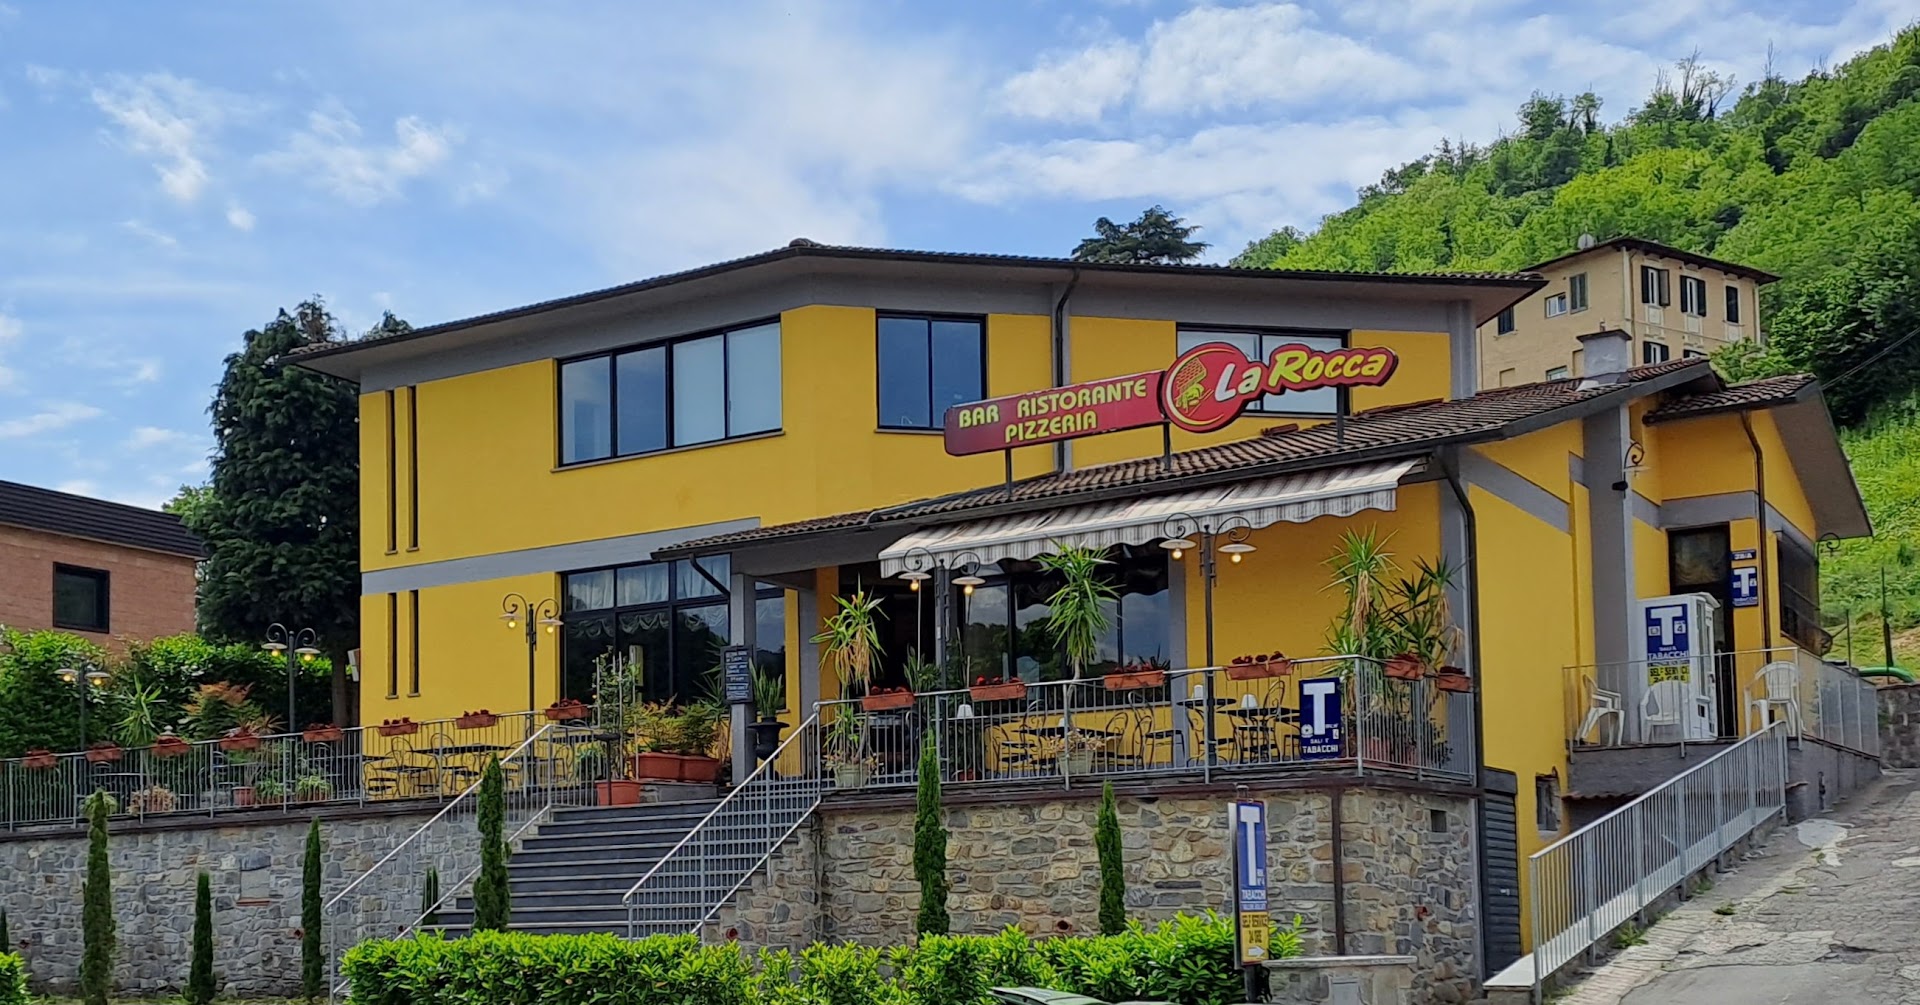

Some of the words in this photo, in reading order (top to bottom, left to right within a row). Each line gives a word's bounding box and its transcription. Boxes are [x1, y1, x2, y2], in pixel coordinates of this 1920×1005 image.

[1214, 363, 1262, 402] La
[1267, 350, 1387, 387] Rocca
[958, 404, 999, 428] BAR
[1017, 378, 1147, 418] RISTORANTE
[1005, 410, 1098, 443] PIZZERIA
[1733, 567, 1756, 597] T
[1650, 606, 1683, 646] T
[1647, 651, 1689, 660] TABACCHI
[1302, 682, 1336, 735] T
[1302, 744, 1339, 754] TABACCHI
[1240, 805, 1261, 886] T
